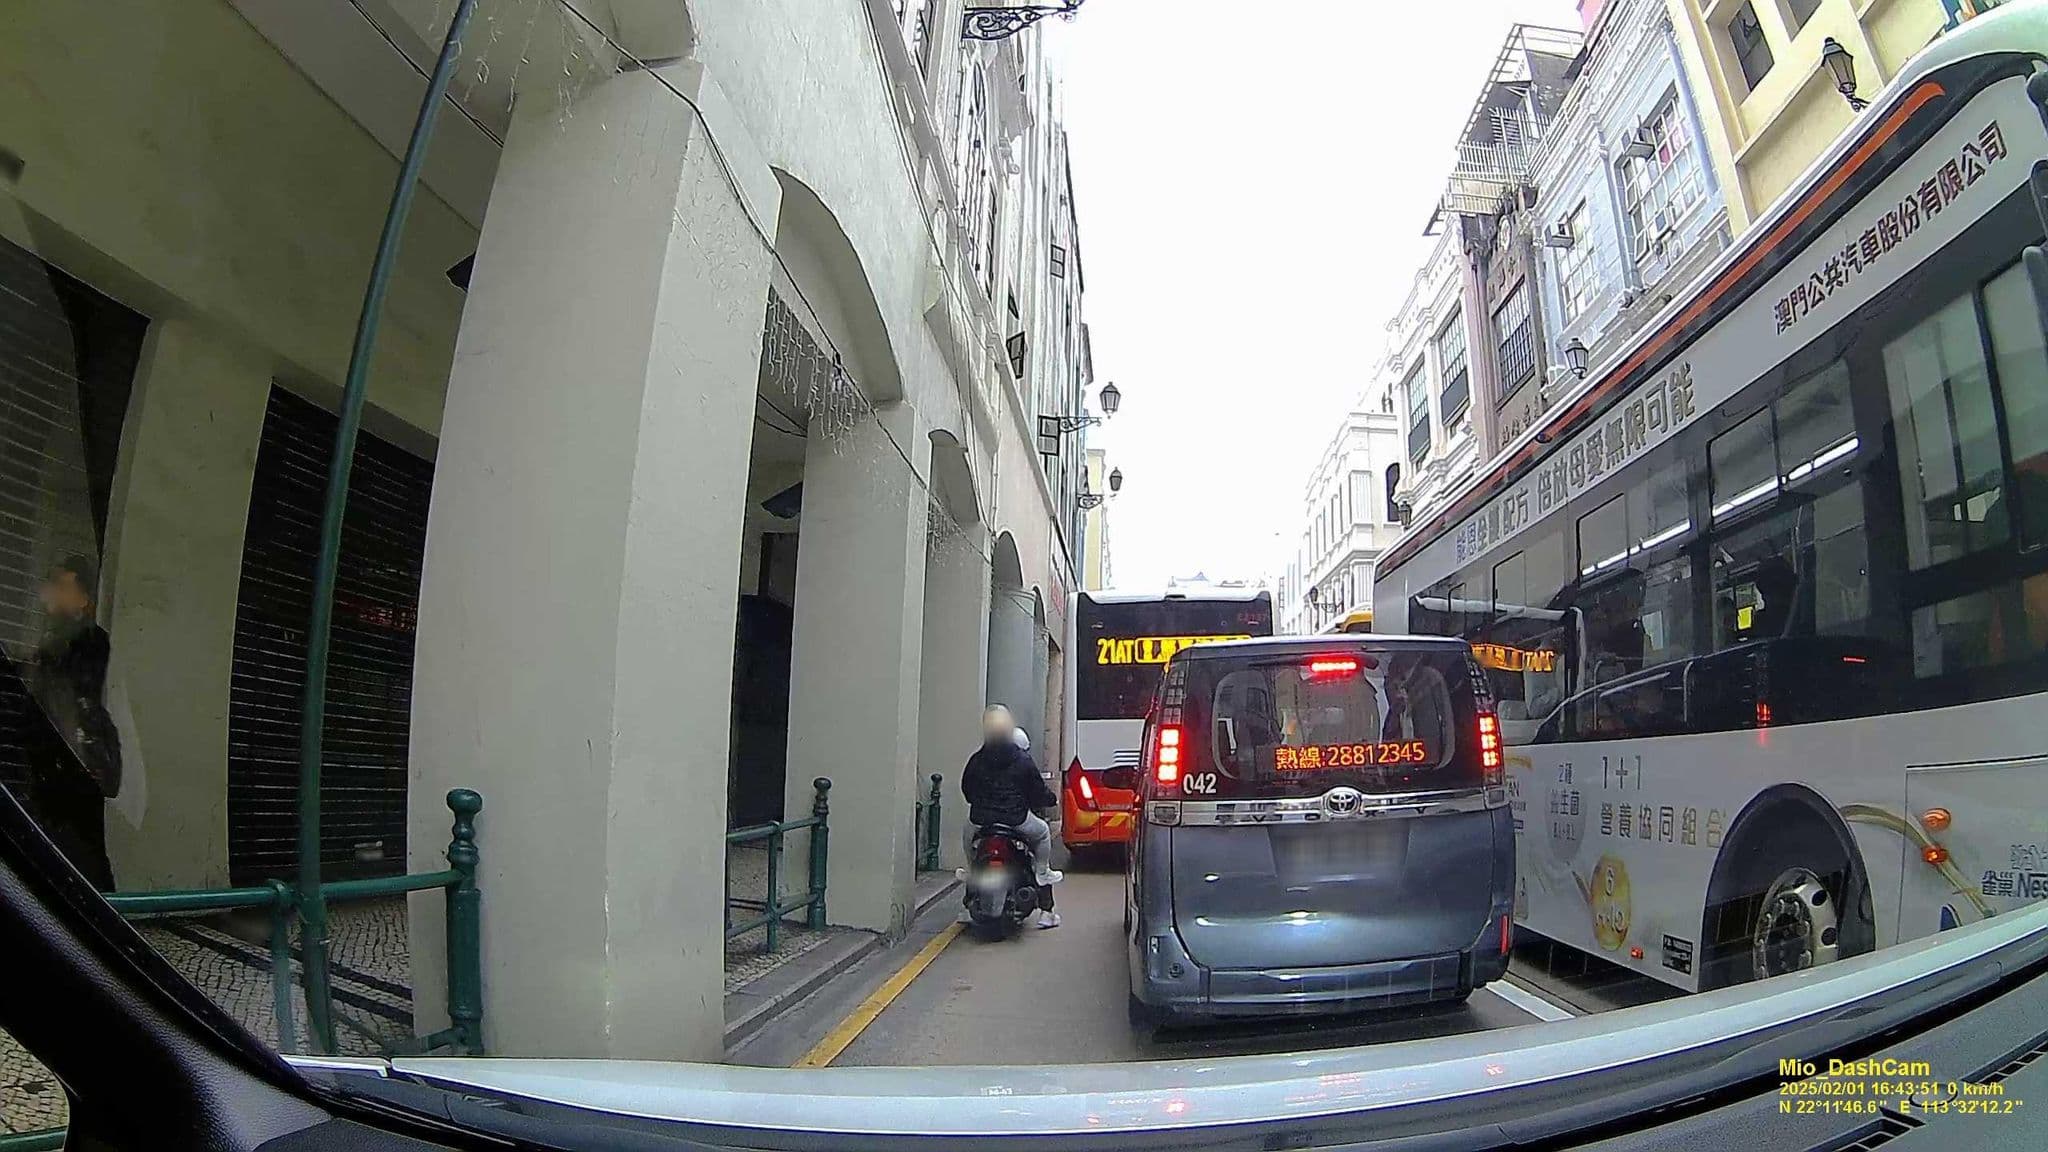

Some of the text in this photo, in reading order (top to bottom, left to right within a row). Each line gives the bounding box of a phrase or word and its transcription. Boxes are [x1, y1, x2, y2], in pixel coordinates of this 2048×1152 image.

[1774, 120, 2007, 335] 澳門公共汽車股份有限公司
[1097, 638, 1136, 664] 21AT
[1275, 742, 1426, 770] 熱線:28812345
[1183, 773, 1217, 794] 042
[1602, 756, 1641, 790] 1+1
[1600, 803, 1722, 848] 營養協同組合
[1981, 870, 2014, 897] 雀巢
